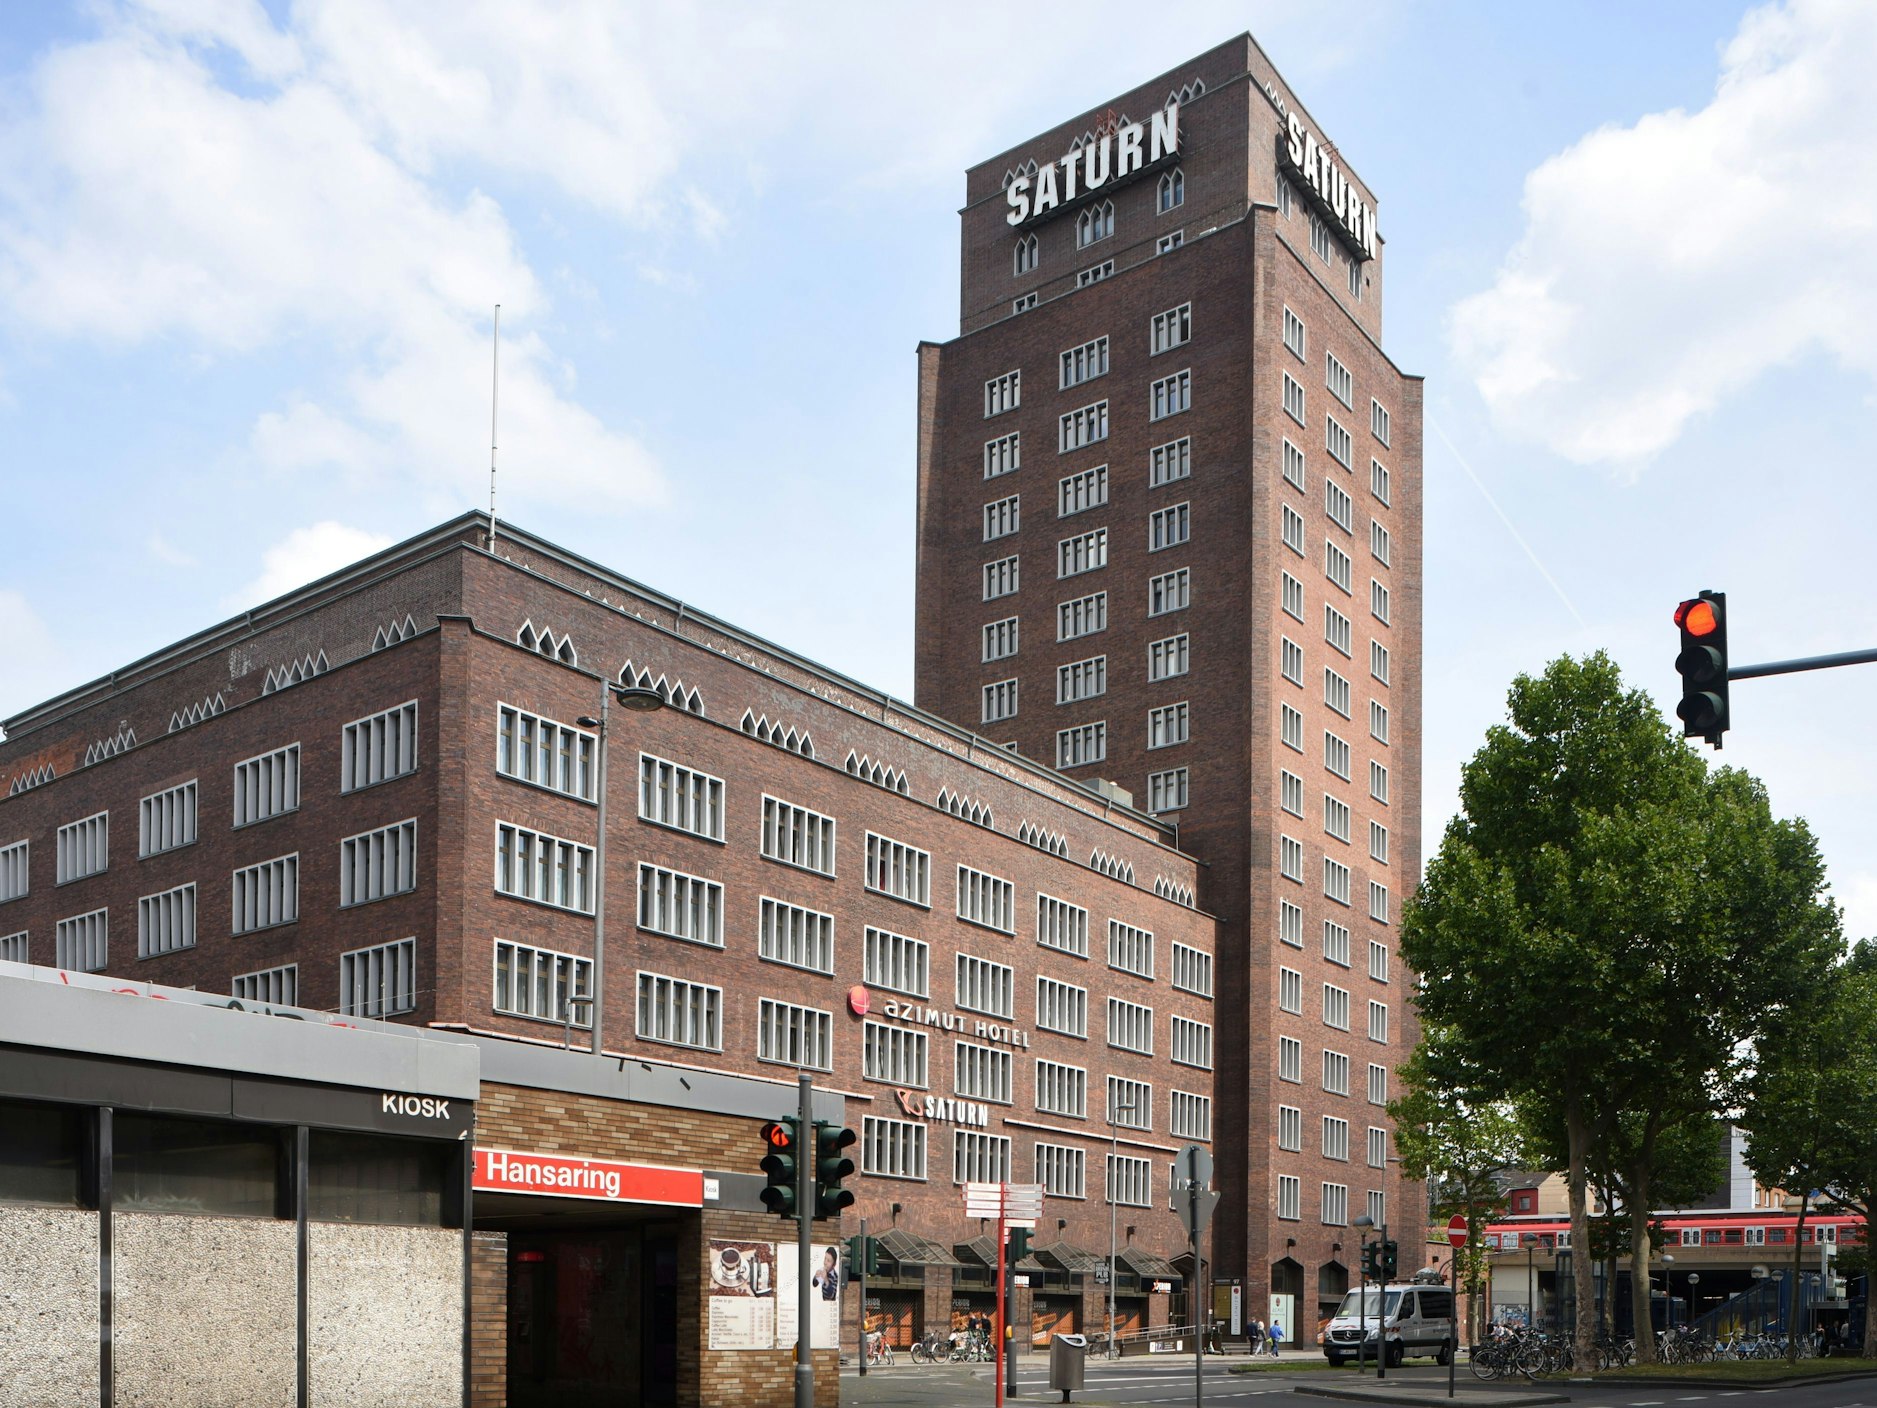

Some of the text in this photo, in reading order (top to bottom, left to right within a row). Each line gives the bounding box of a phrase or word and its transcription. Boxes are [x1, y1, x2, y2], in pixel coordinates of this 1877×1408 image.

[1006, 102, 1178, 226] SATURN
[1288, 111, 1376, 260] SATURN
[974, 1020, 1030, 1048] HOTEL
[382, 1093, 451, 1120] KIOSK
[924, 1094, 988, 1127] SATURN
[487, 1152, 621, 1198] Hansaring
